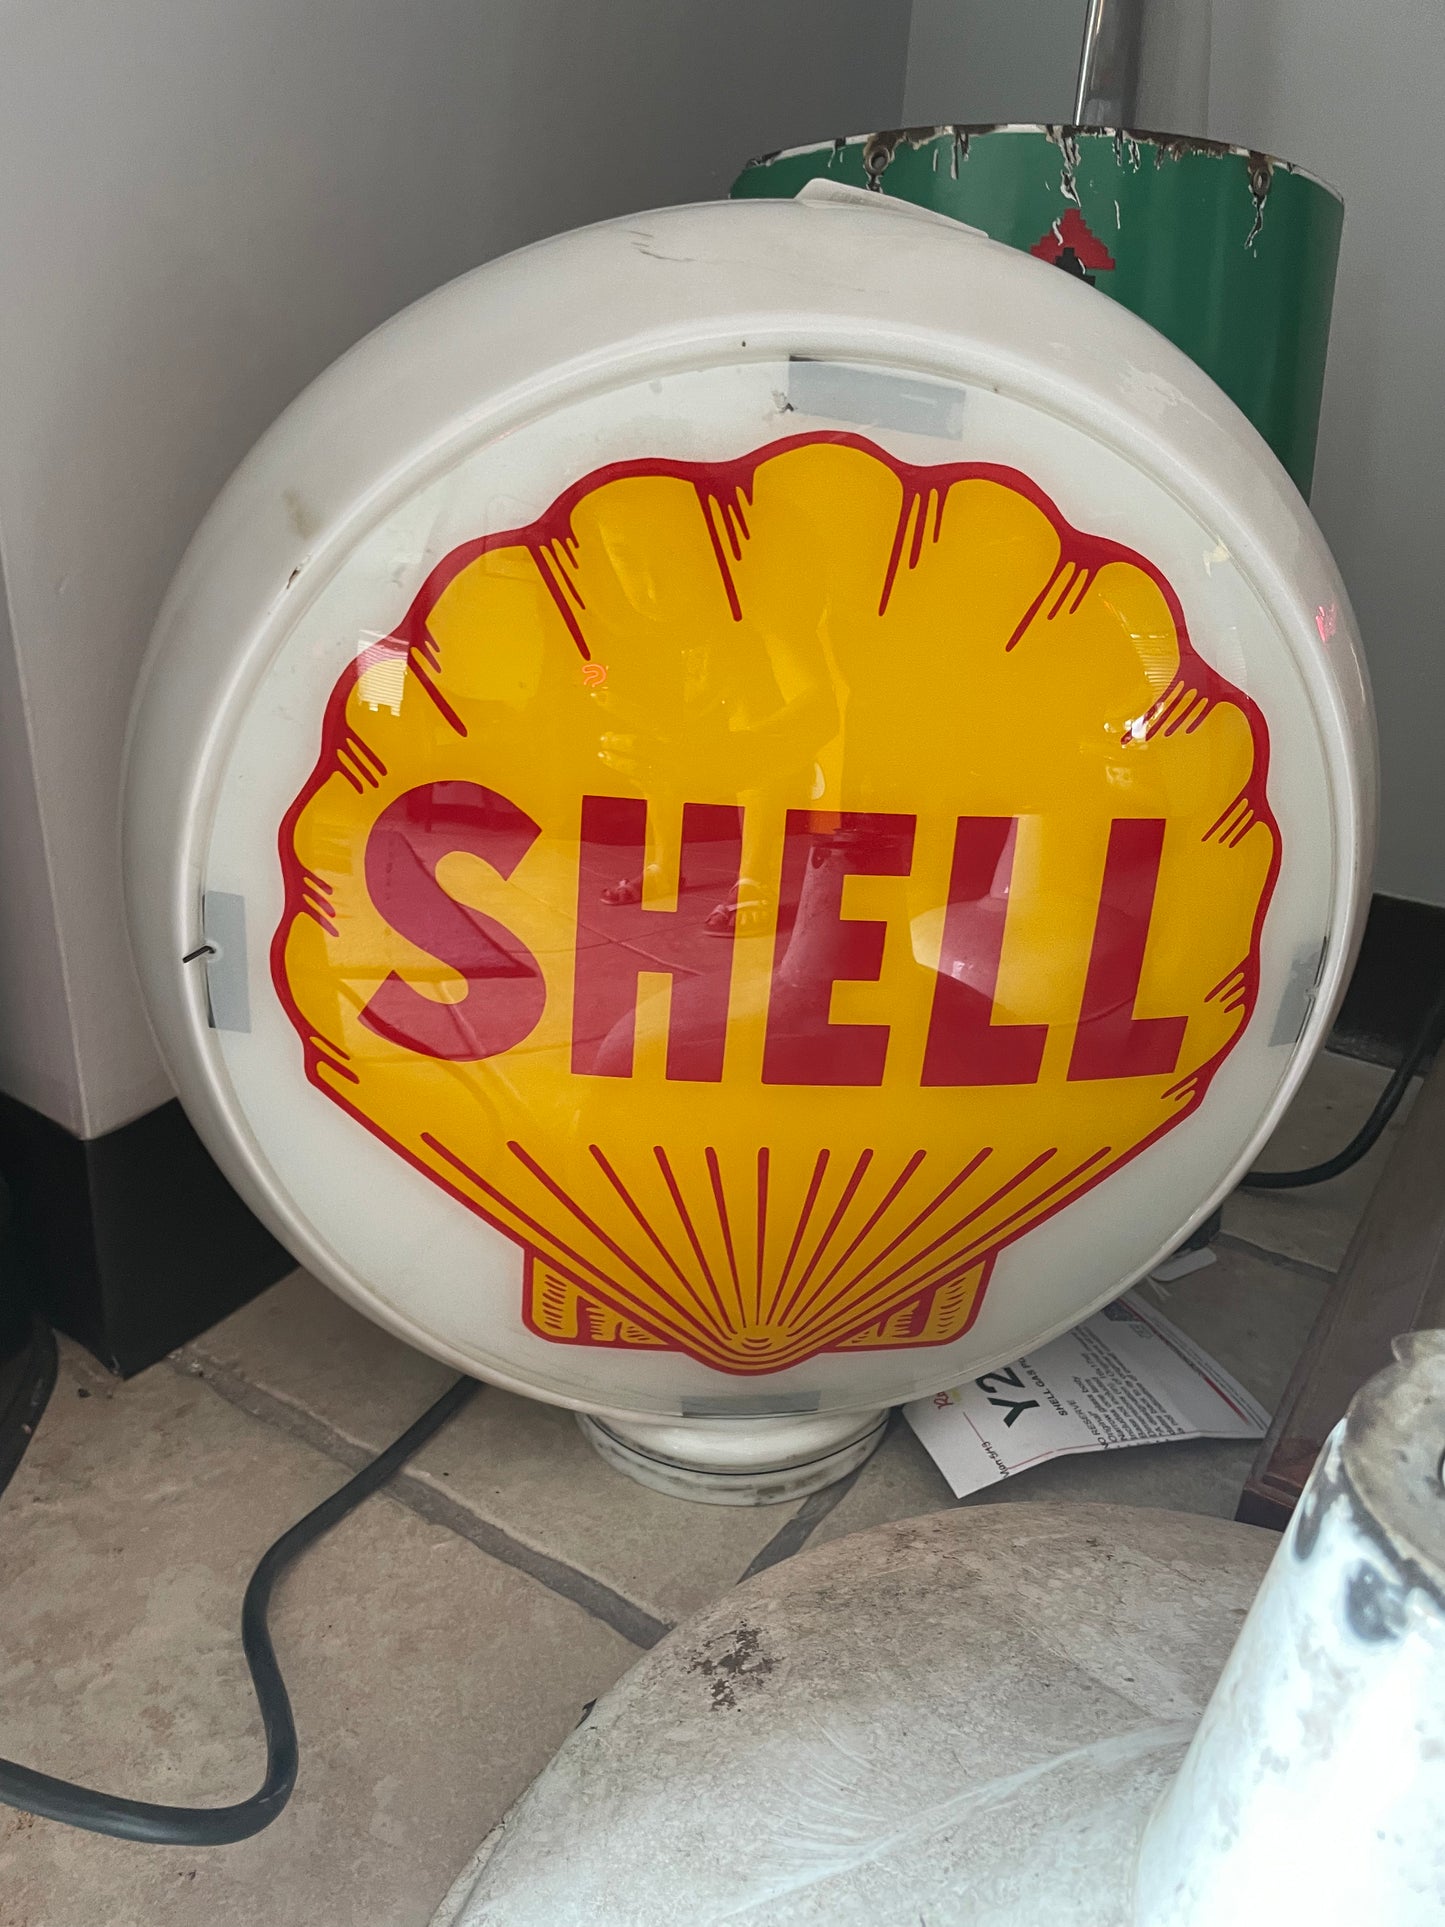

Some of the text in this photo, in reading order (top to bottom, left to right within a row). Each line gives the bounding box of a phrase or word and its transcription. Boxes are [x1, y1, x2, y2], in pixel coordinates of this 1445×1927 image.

[361, 781, 1188, 1084] SHELL
[1026, 1370, 1045, 1388] GAS
[976, 1366, 1040, 1428] Y2
[1043, 1388, 1068, 1416] SHELL
[1066, 1400, 1100, 1436] RESERVE
[1103, 1413, 1127, 1441] Narrow
[1097, 1436, 1109, 1449] NO
